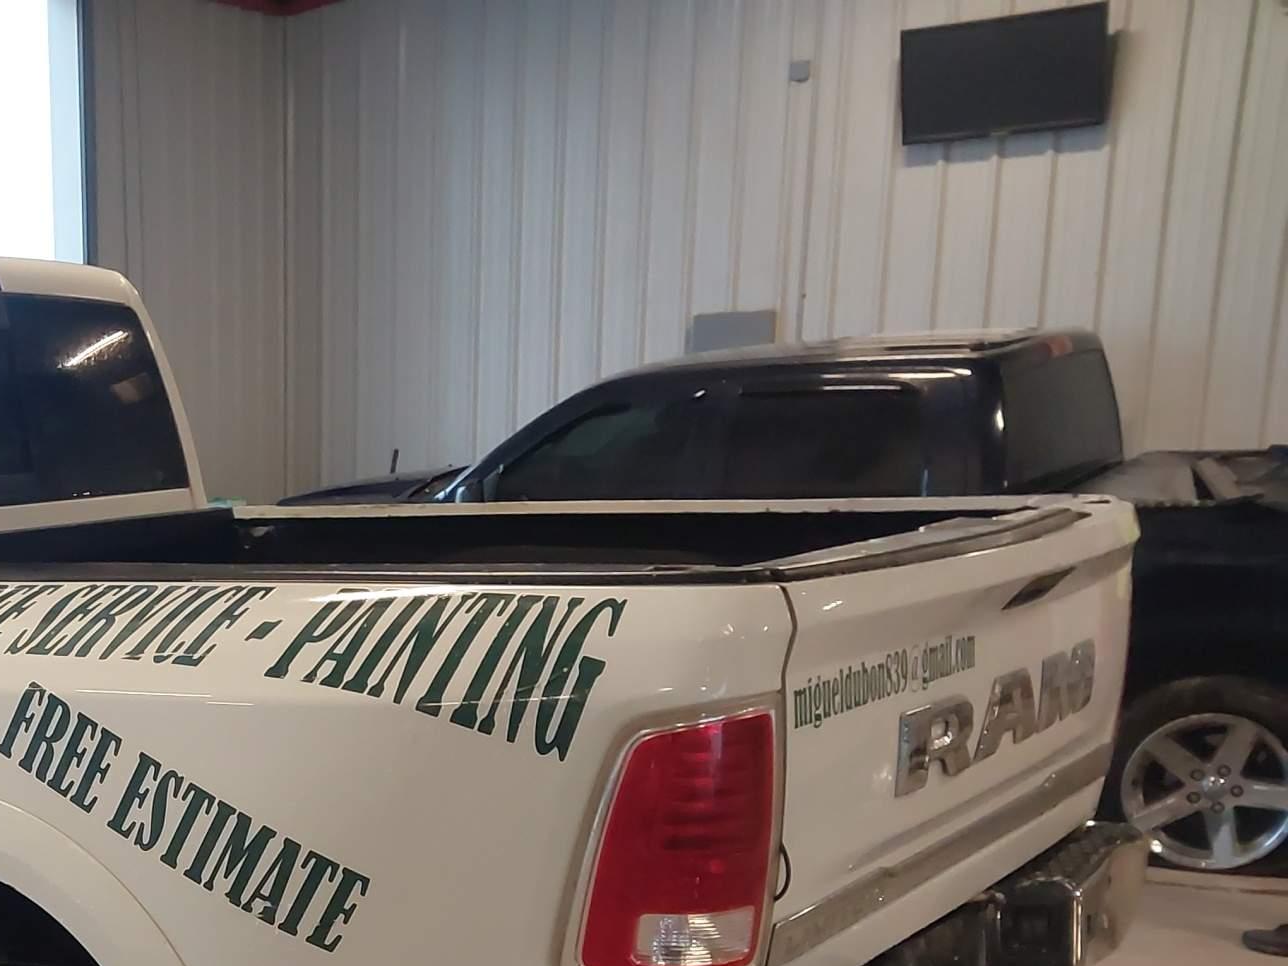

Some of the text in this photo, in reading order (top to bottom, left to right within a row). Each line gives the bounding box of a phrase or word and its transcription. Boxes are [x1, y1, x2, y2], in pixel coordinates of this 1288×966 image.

[4, 584, 277, 667] SERVICE
[263, 588, 628, 762] PAINTING
[793, 635, 975, 729] migueldubon839@gmail.com
[894, 638, 1096, 798] RAM
[107, 751, 371, 953] ESTIMATE
